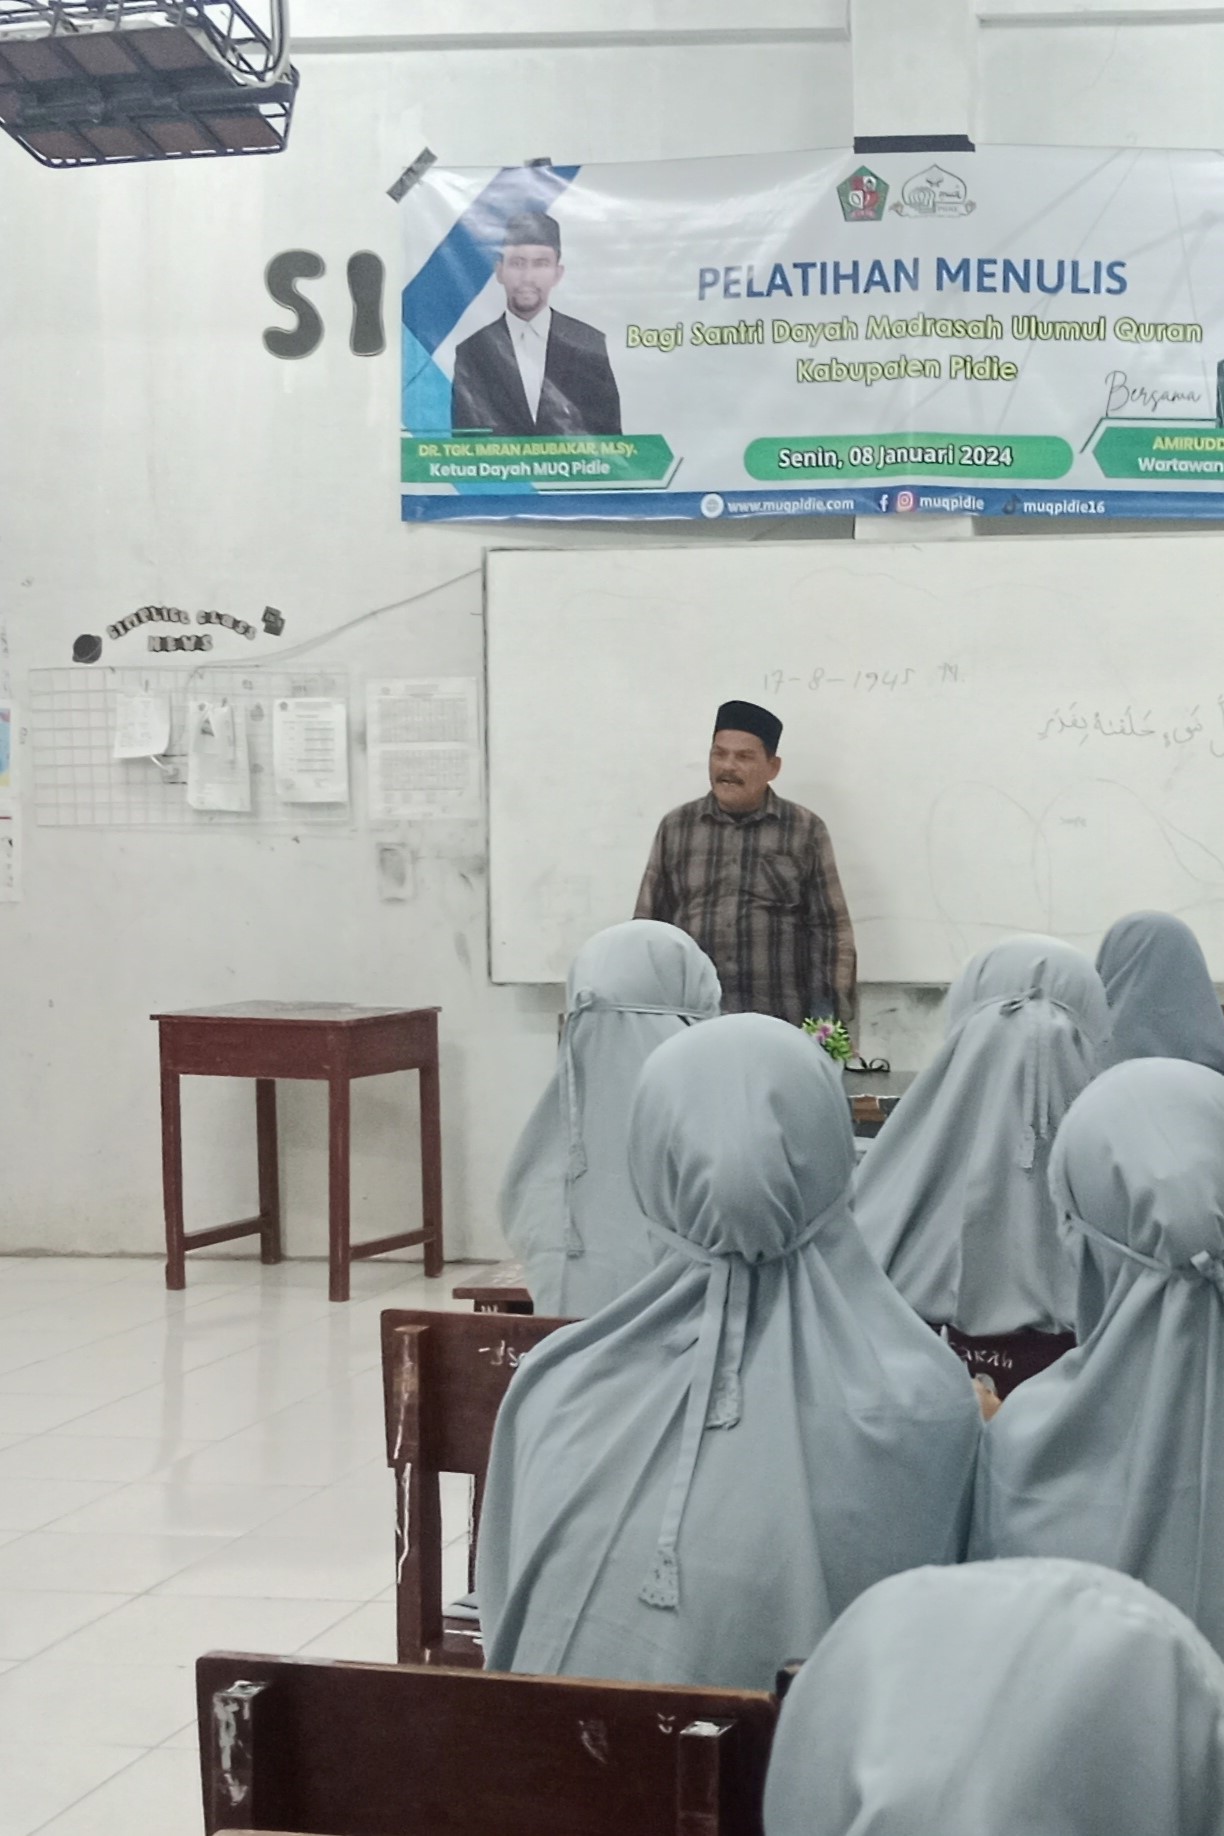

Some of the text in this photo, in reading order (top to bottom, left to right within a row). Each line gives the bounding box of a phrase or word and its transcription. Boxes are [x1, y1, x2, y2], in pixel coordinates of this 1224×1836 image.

[697, 256, 1129, 301] PELATIHAN MENULIS
[626, 311, 1203, 352] Bagi Santri Dayah Madrasah Ulumul Quran
[796, 355, 1019, 386] Kabupaten Pidie
[1103, 369, 1201, 413] Bersama
[418, 443, 441, 457] DR.
[443, 443, 474, 457] TGK.
[475, 443, 522, 457] IMRAN
[777, 444, 1014, 470] Senin, 08 Januari 2024
[429, 458, 611, 479] Ketua Dayah MUQ Pidie
[1138, 457, 1224, 473] Wartawan
[726, 497, 855, 515] www.muqpidie.com
[919, 492, 985, 511] muqpidie
[1022, 498, 1106, 516] muqpidie16
[147, 634, 215, 652] NEWS
